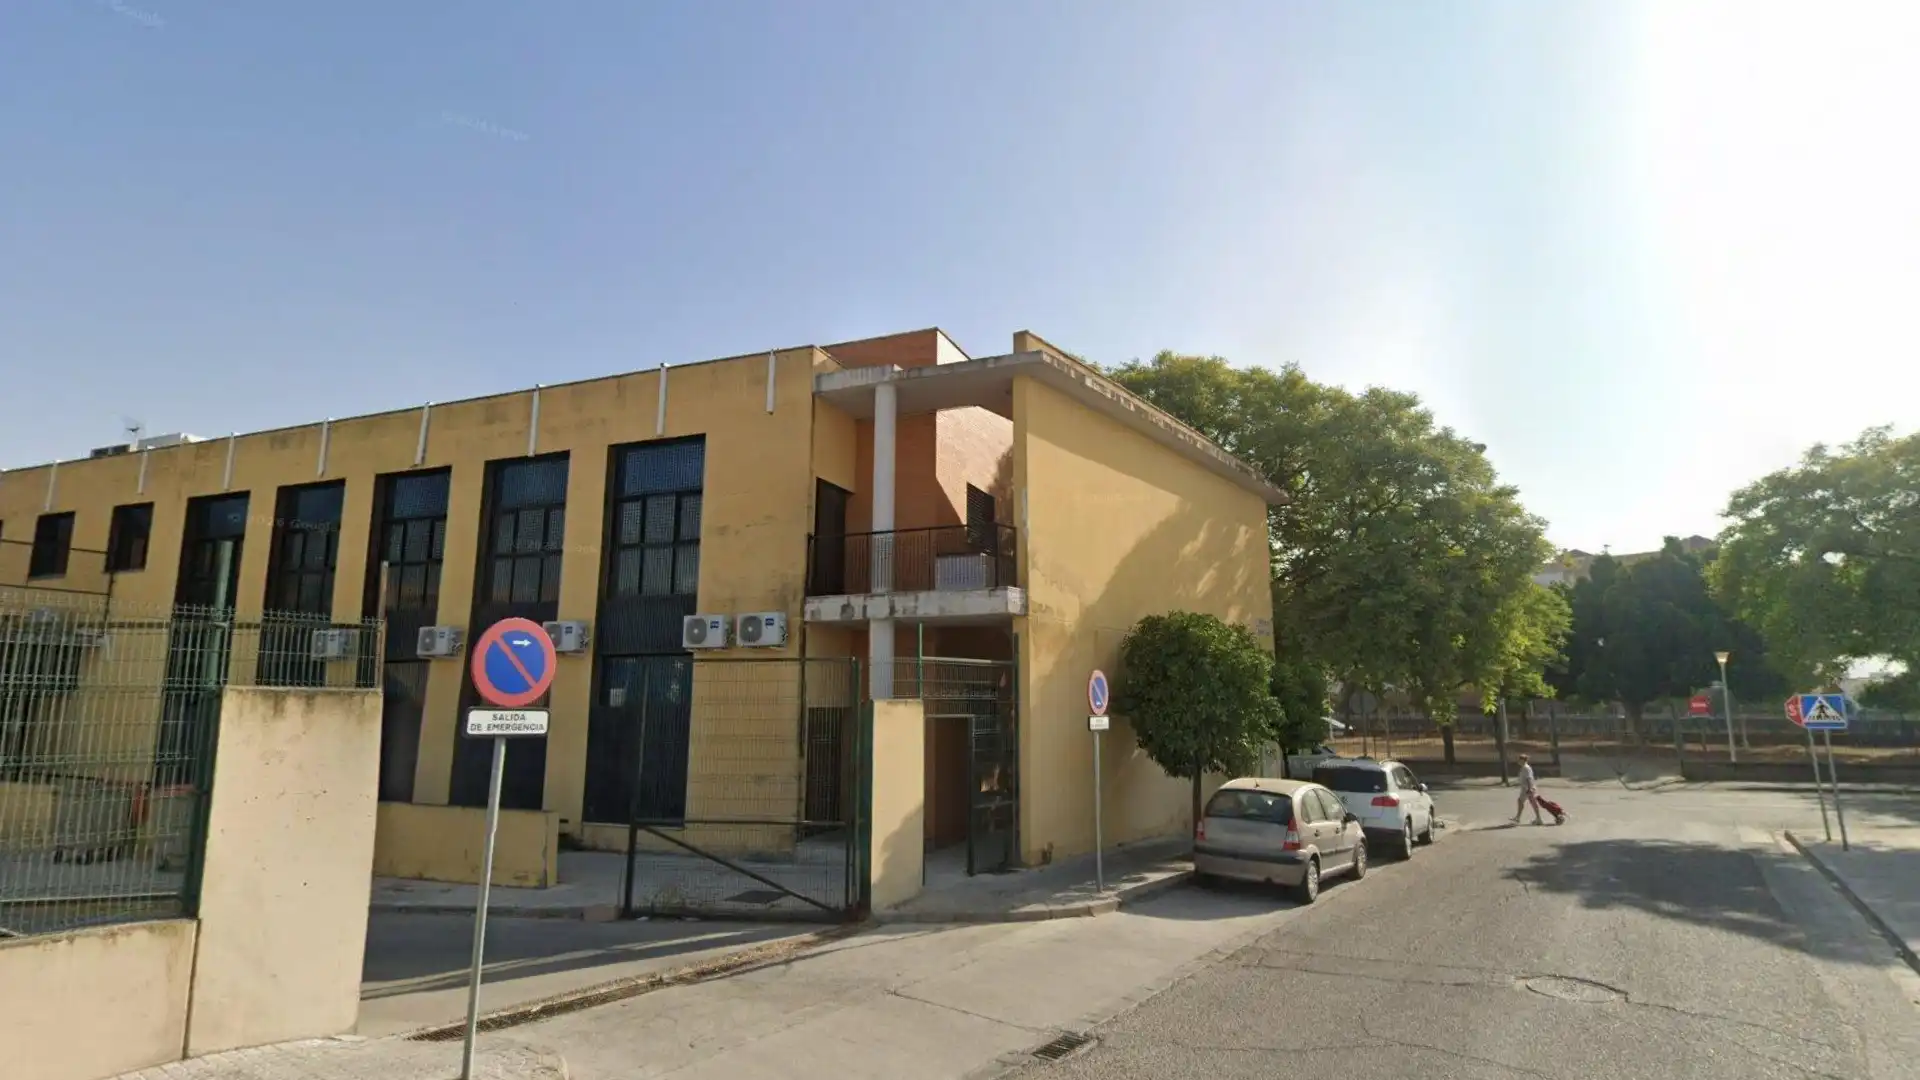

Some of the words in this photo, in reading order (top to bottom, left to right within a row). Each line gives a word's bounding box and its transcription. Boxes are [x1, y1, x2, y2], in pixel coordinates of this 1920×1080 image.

[492, 713, 526, 721] SALIDA
[470, 723, 483, 732] DE
[486, 723, 545, 732] EMERGENCIA
